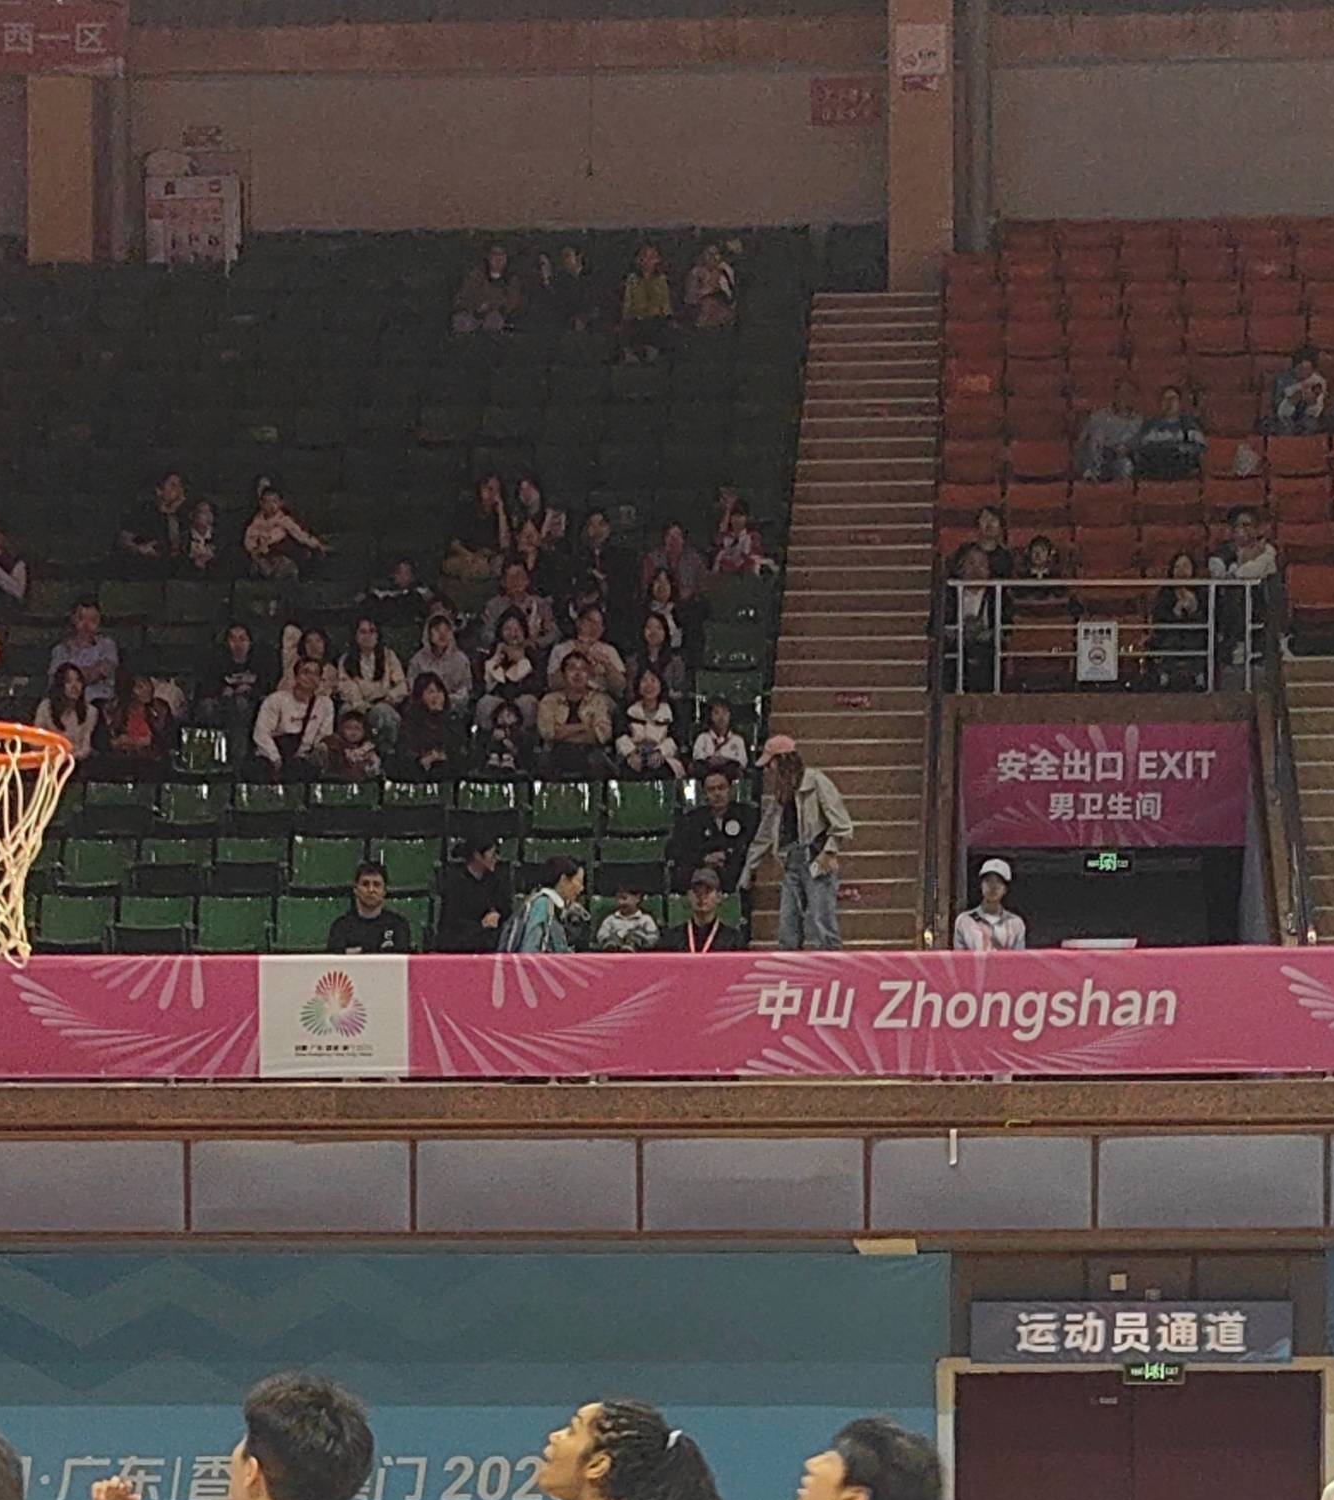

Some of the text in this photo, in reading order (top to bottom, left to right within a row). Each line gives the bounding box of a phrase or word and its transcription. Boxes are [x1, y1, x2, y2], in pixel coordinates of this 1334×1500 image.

[996, 750, 1216, 782] 安全出口 EXIT
[1048, 792, 1162, 821] 男卫生间
[757, 978, 1178, 1041] 中山 Zhongshan
[1014, 1311, 1249, 1355] 运动员通道
